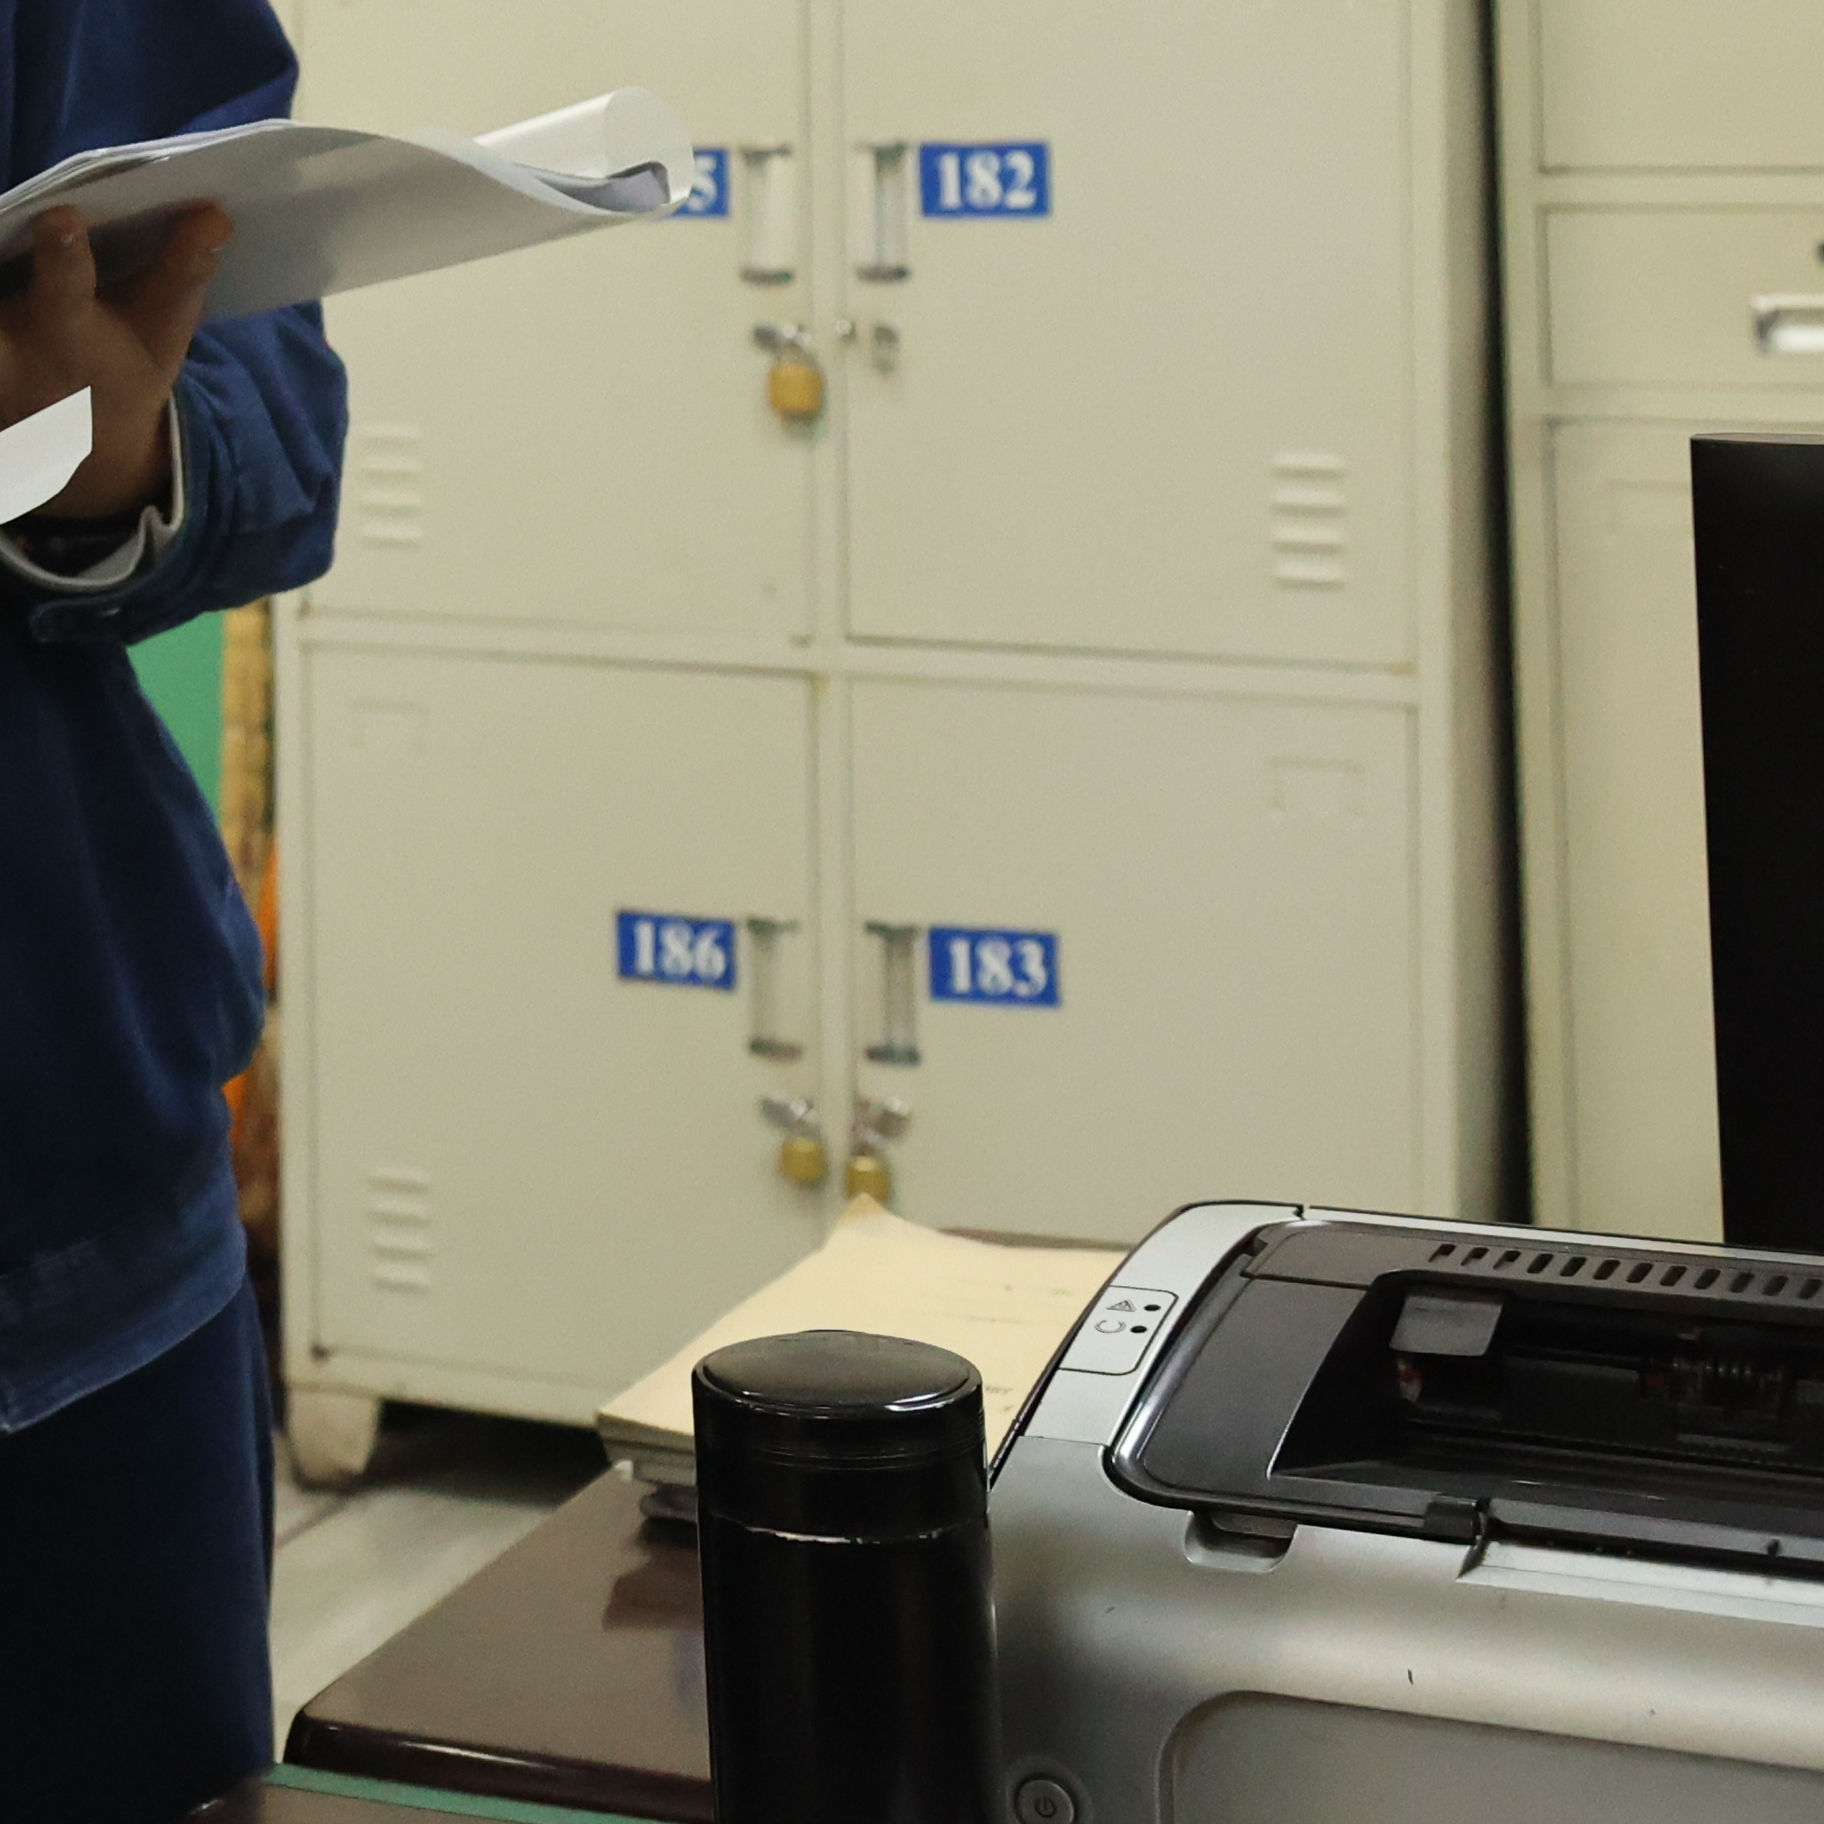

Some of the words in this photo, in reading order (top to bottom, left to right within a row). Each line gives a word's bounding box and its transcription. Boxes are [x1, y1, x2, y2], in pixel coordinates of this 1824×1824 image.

[938, 148, 1038, 210] 182
[633, 919, 727, 982] 186
[950, 937, 1048, 997] 183
